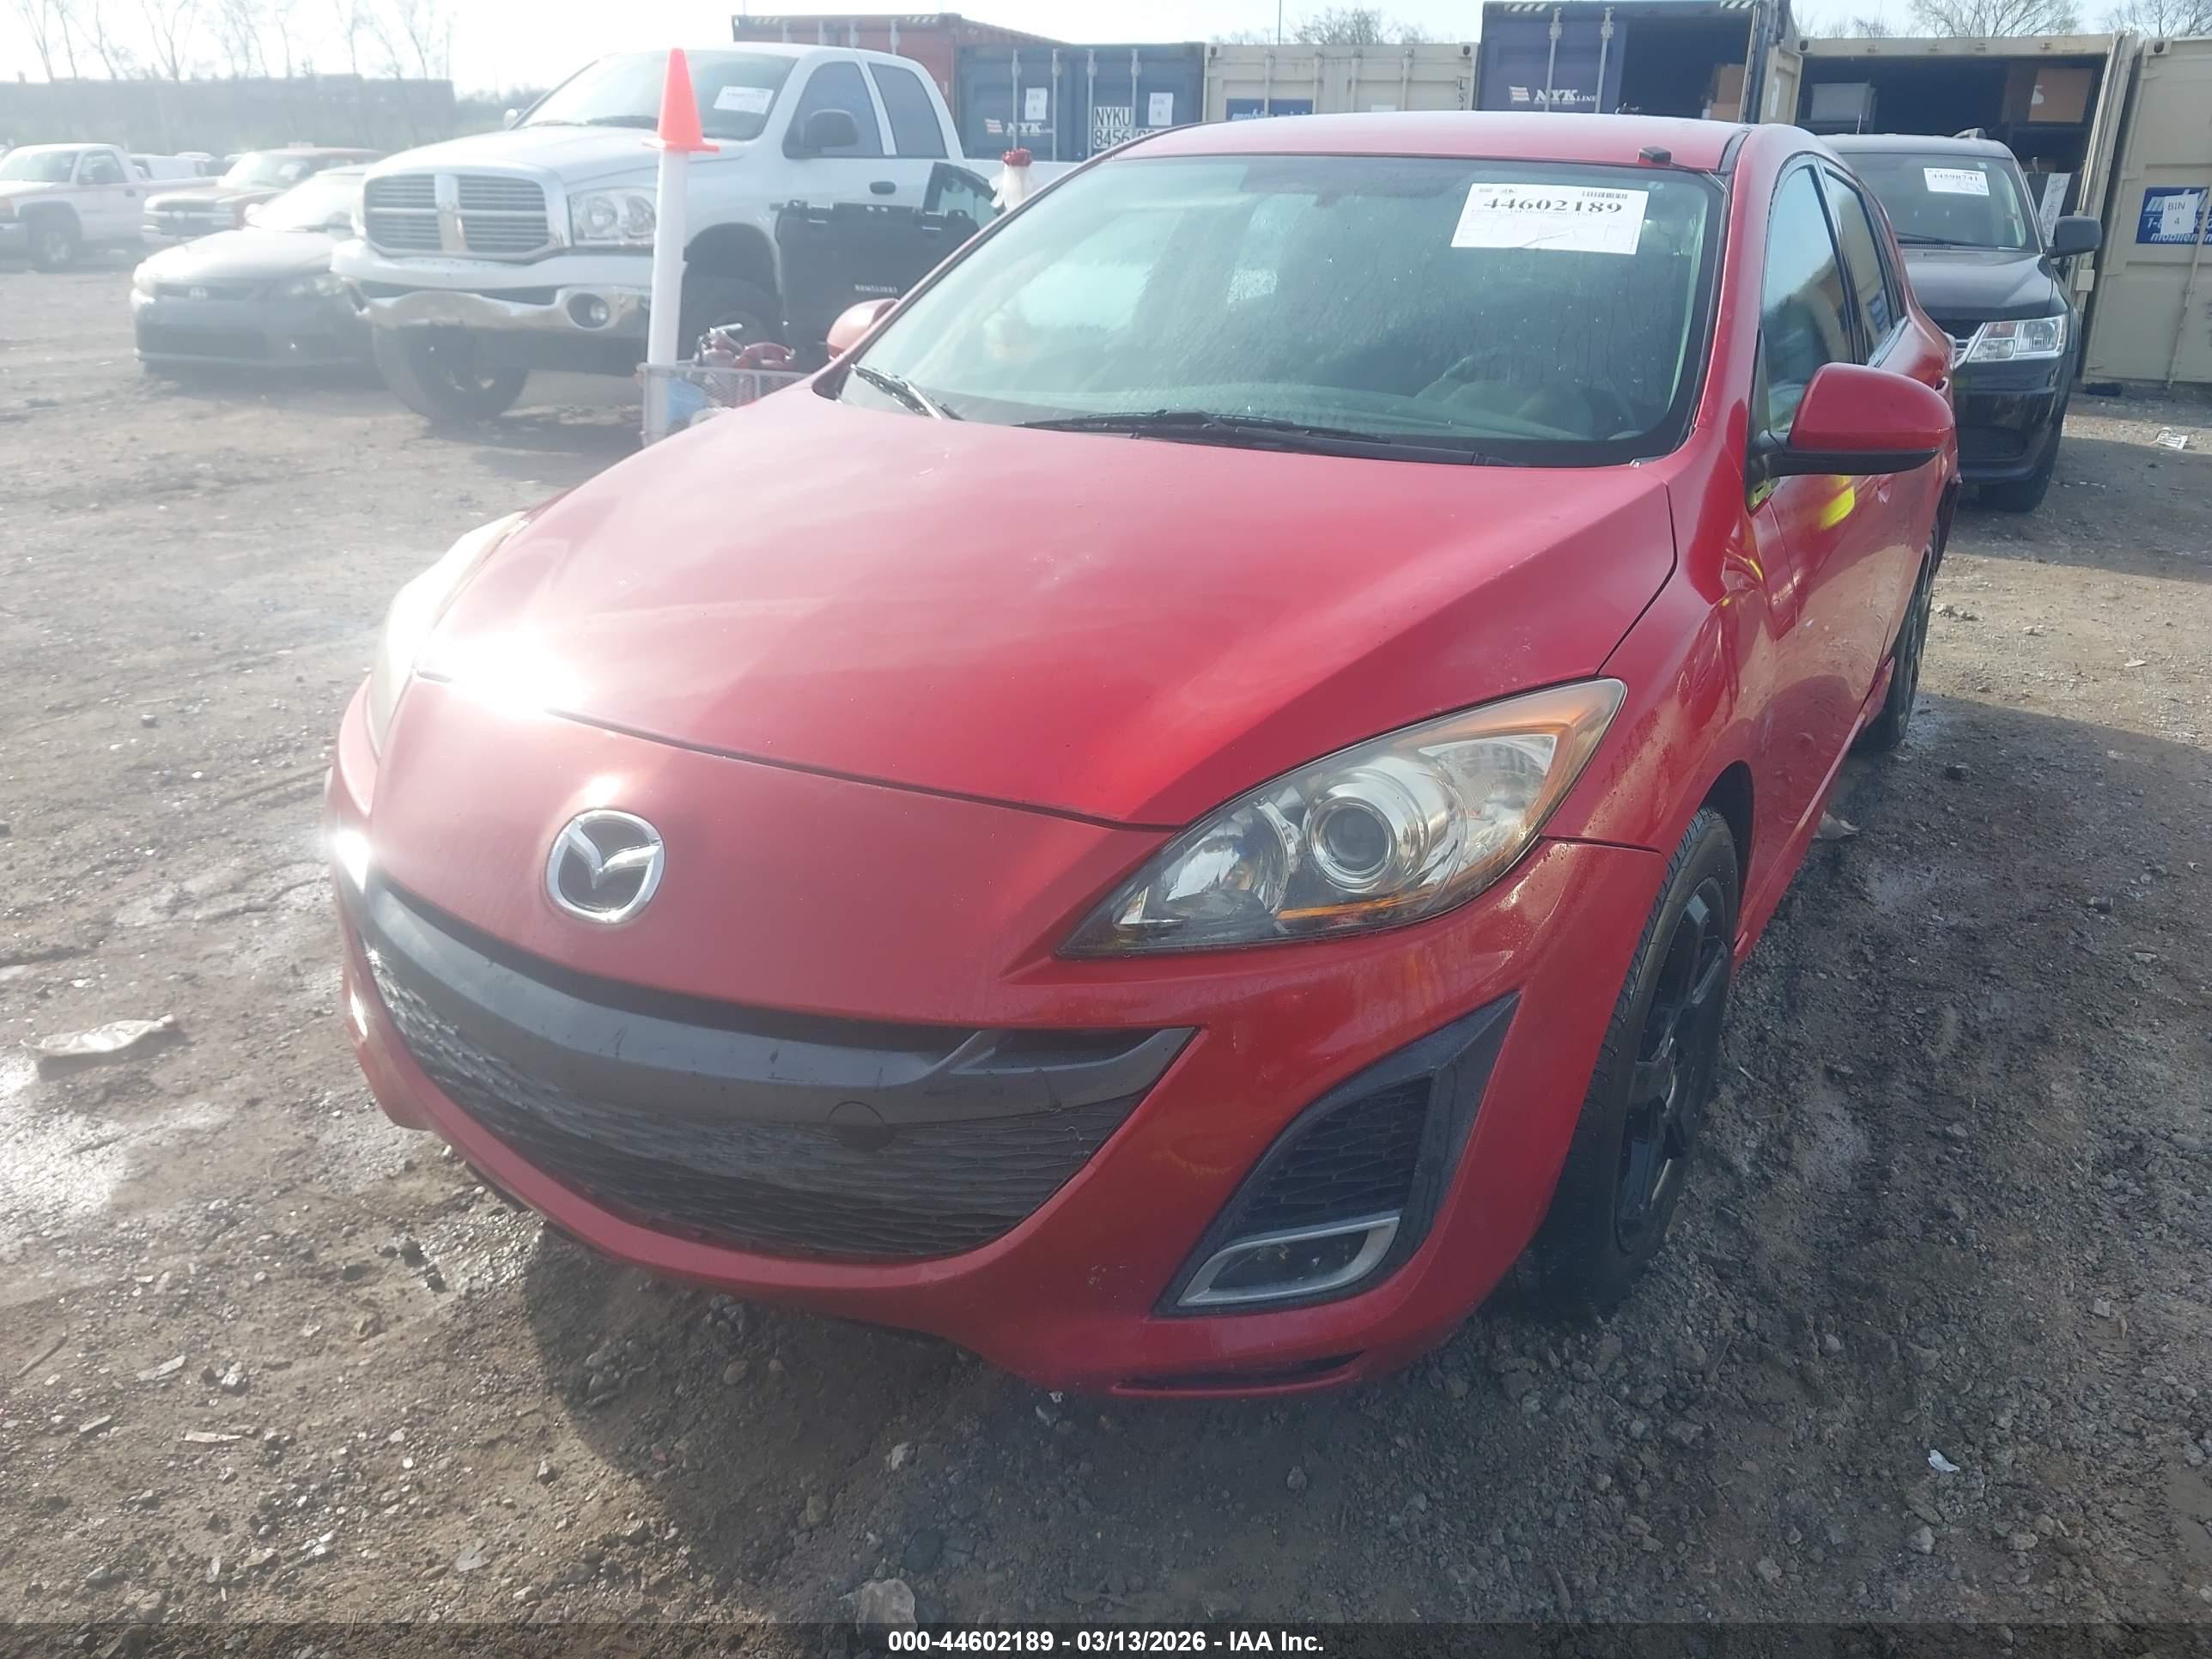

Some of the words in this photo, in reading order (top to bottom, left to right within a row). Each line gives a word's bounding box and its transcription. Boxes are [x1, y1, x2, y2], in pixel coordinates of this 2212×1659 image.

[1534, 88, 1577, 102] NYK
[1095, 107, 1132, 126] NYKU
[1483, 198, 1623, 214] 44602189
[2167, 202, 2185, 210] BIN
